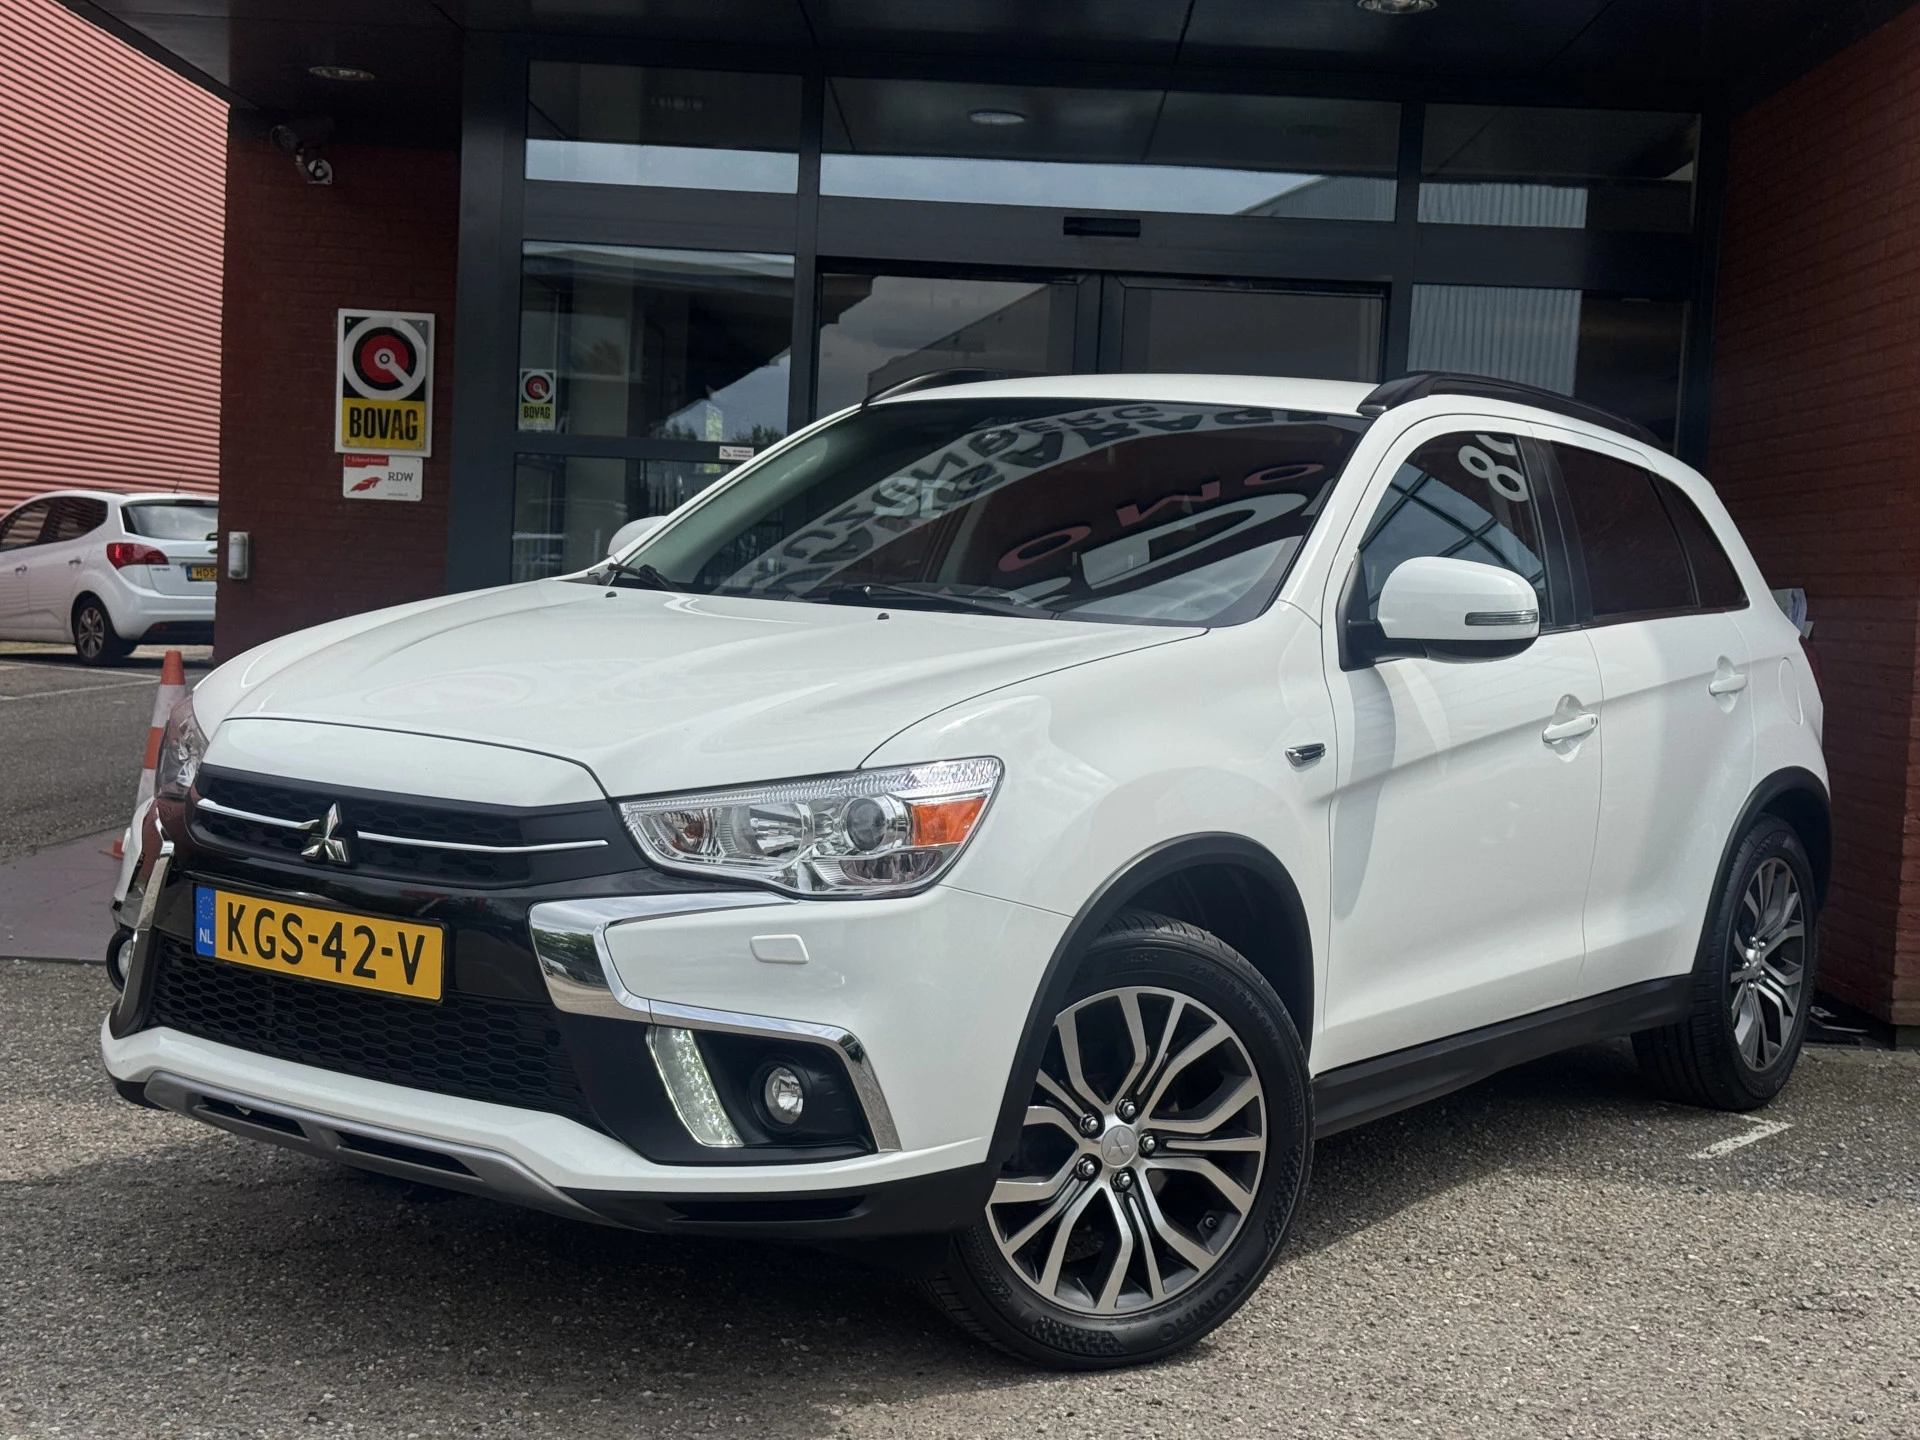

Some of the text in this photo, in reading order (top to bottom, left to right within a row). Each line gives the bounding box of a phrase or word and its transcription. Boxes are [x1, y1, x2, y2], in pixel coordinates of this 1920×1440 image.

[349, 406, 418, 441] BOVAG
[523, 405, 551, 420] BOVAG
[388, 471, 414, 482] RDW
[199, 927, 214, 945] NL
[227, 901, 426, 985] KGS-42-V
[1158, 1272, 1249, 1341] KUMHO
